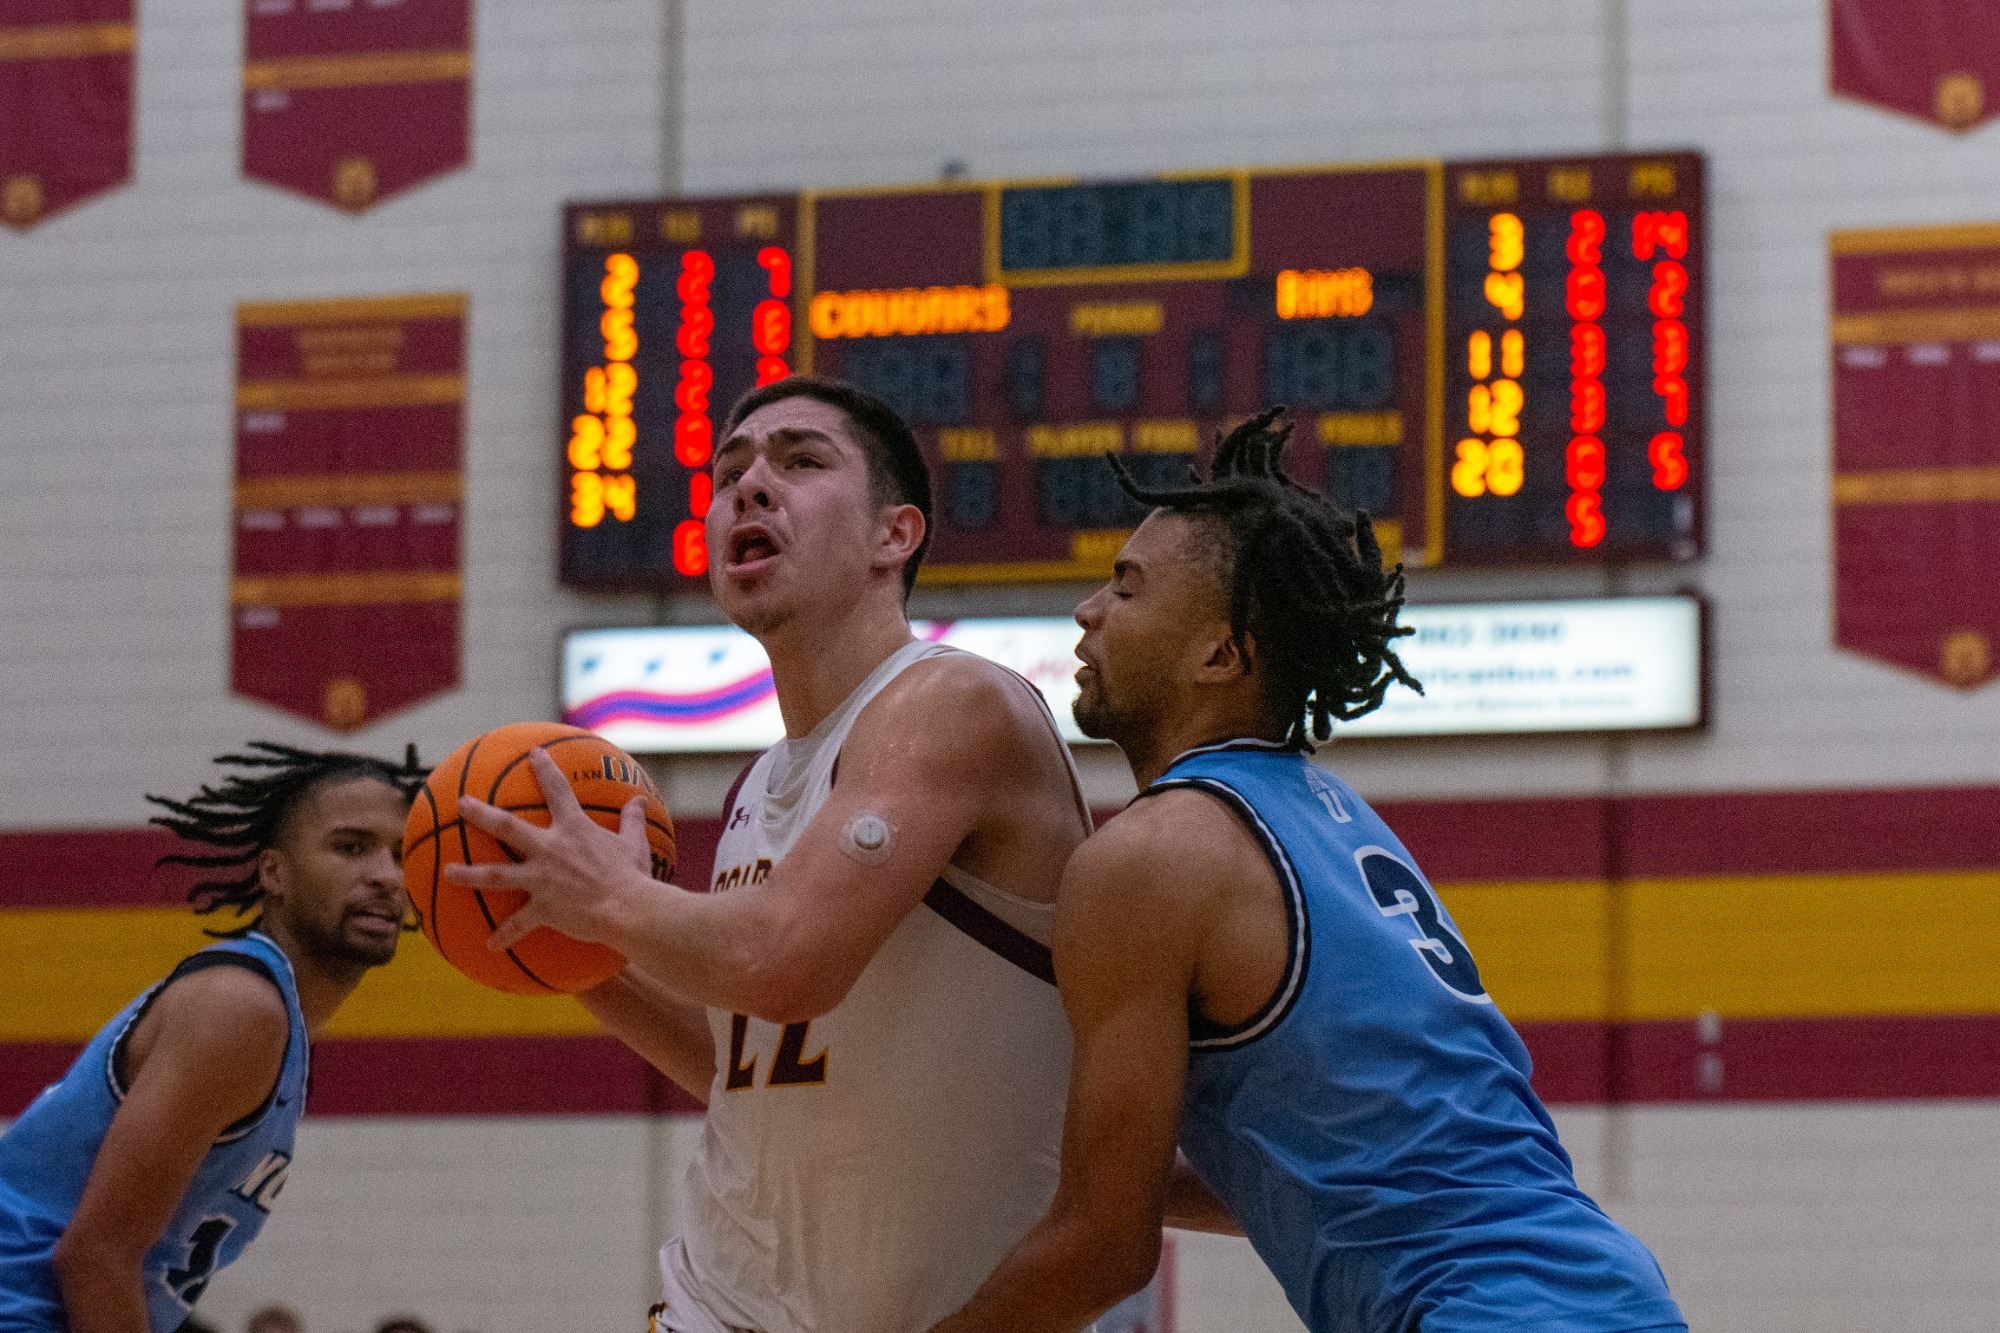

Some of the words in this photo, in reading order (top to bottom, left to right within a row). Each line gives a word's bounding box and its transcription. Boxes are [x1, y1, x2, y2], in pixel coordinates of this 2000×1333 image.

[1489, 212, 1524, 271] 3
[1566, 209, 1606, 266] 2
[601, 253, 639, 309] 2
[676, 250, 714, 304] 2
[757, 247, 791, 297] 7
[1484, 271, 1524, 320] 4
[1649, 260, 1688, 318] 2
[676, 303, 714, 358] 2
[809, 285, 1010, 338] COUGARS
[1468, 329, 1524, 379] 11
[1653, 319, 1688, 377] 3
[674, 358, 713, 413] 2
[1468, 379, 1524, 437] 12
[1653, 375, 1688, 426] 7
[1452, 438, 1524, 497] 20
[1648, 431, 1688, 491] 5
[1566, 491, 1606, 547] 5
[1354, 845, 1492, 1004] 3
